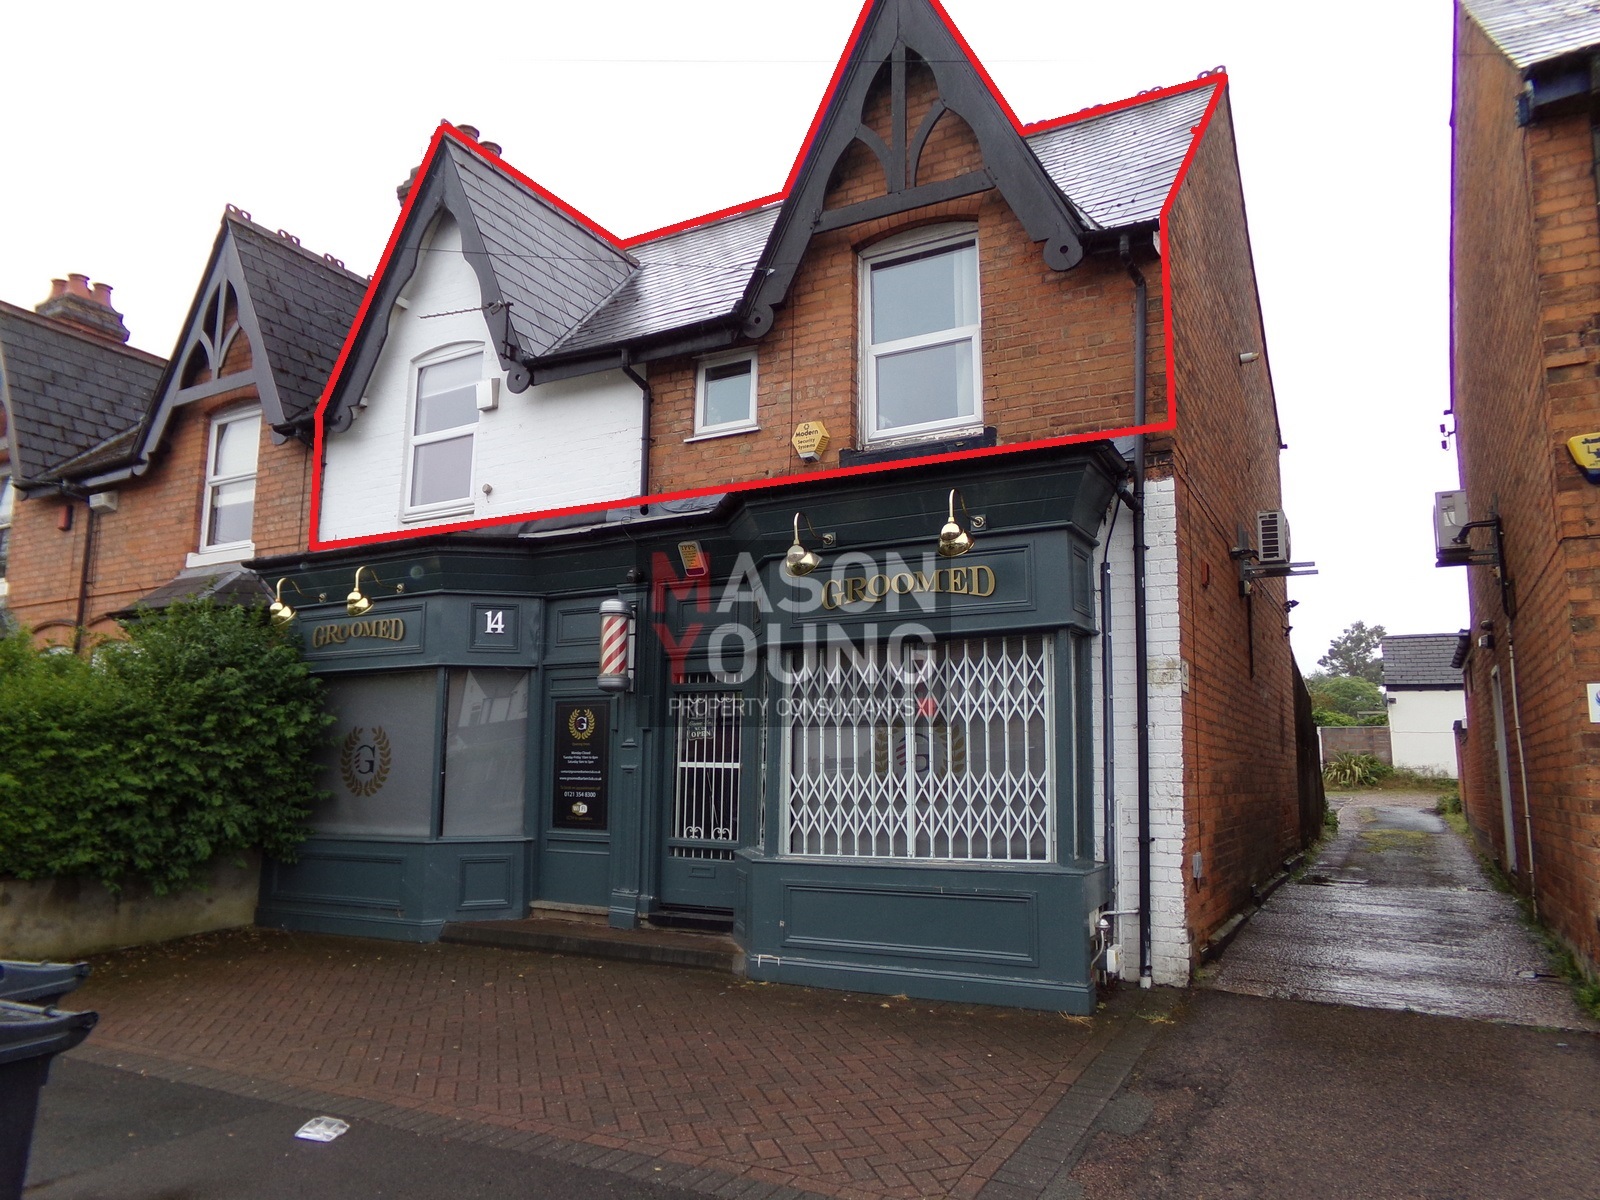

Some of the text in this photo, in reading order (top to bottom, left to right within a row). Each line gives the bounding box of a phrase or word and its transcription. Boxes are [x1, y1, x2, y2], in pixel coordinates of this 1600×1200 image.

[795, 429, 819, 438] Modern
[821, 565, 997, 611] GROOMED
[312, 617, 405, 649] GROOMED
[484, 610, 505, 635] 14
[354, 744, 376, 774] G
